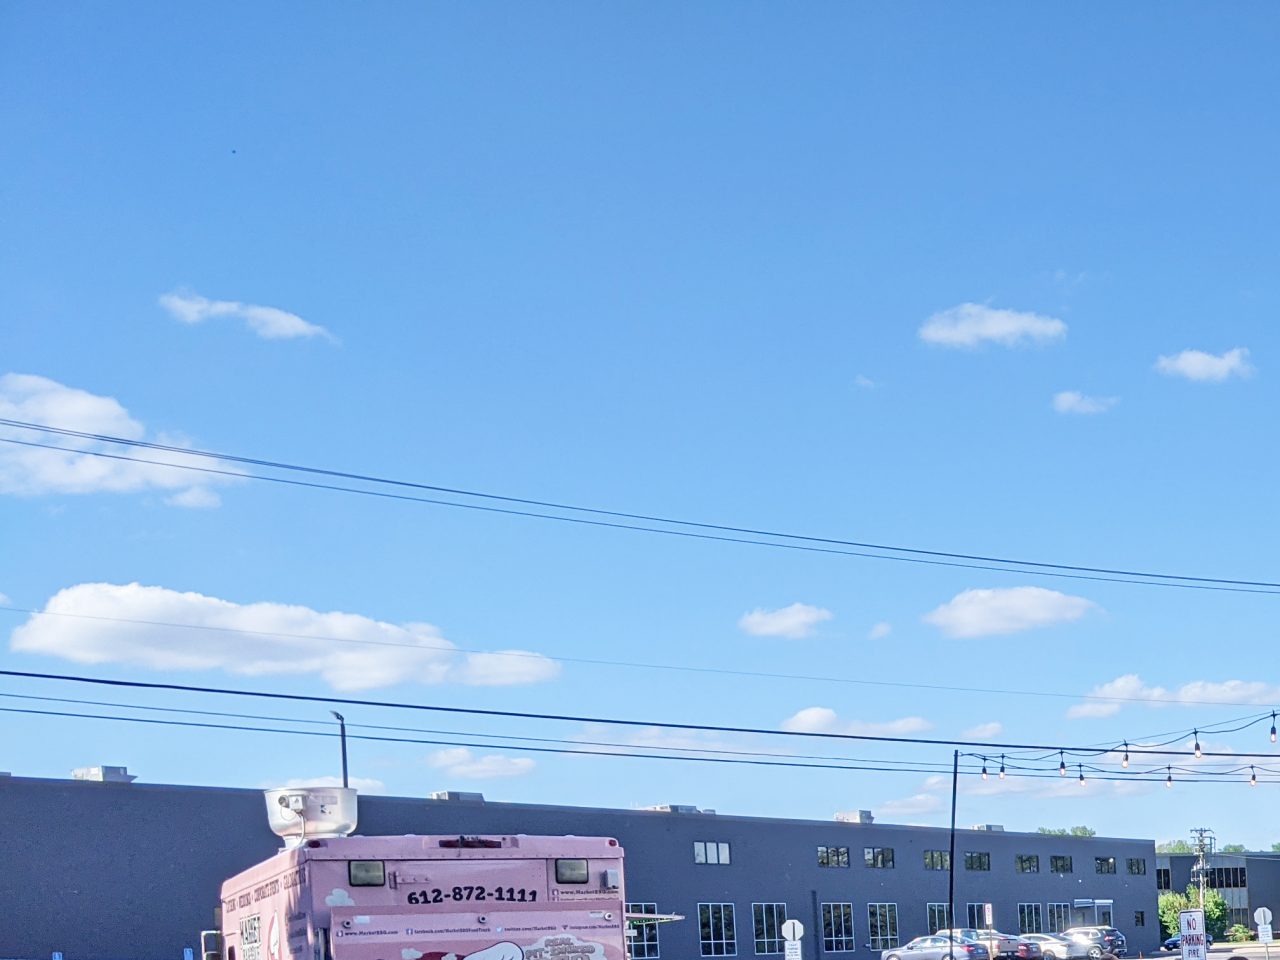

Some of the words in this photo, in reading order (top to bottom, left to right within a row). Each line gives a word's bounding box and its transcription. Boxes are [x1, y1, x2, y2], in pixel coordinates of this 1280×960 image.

[407, 886, 538, 905] 612-872-1111
[1186, 918, 1197, 930] NO
[1181, 933, 1204, 947] PARKING
[1188, 949, 1200, 958] FIRE
